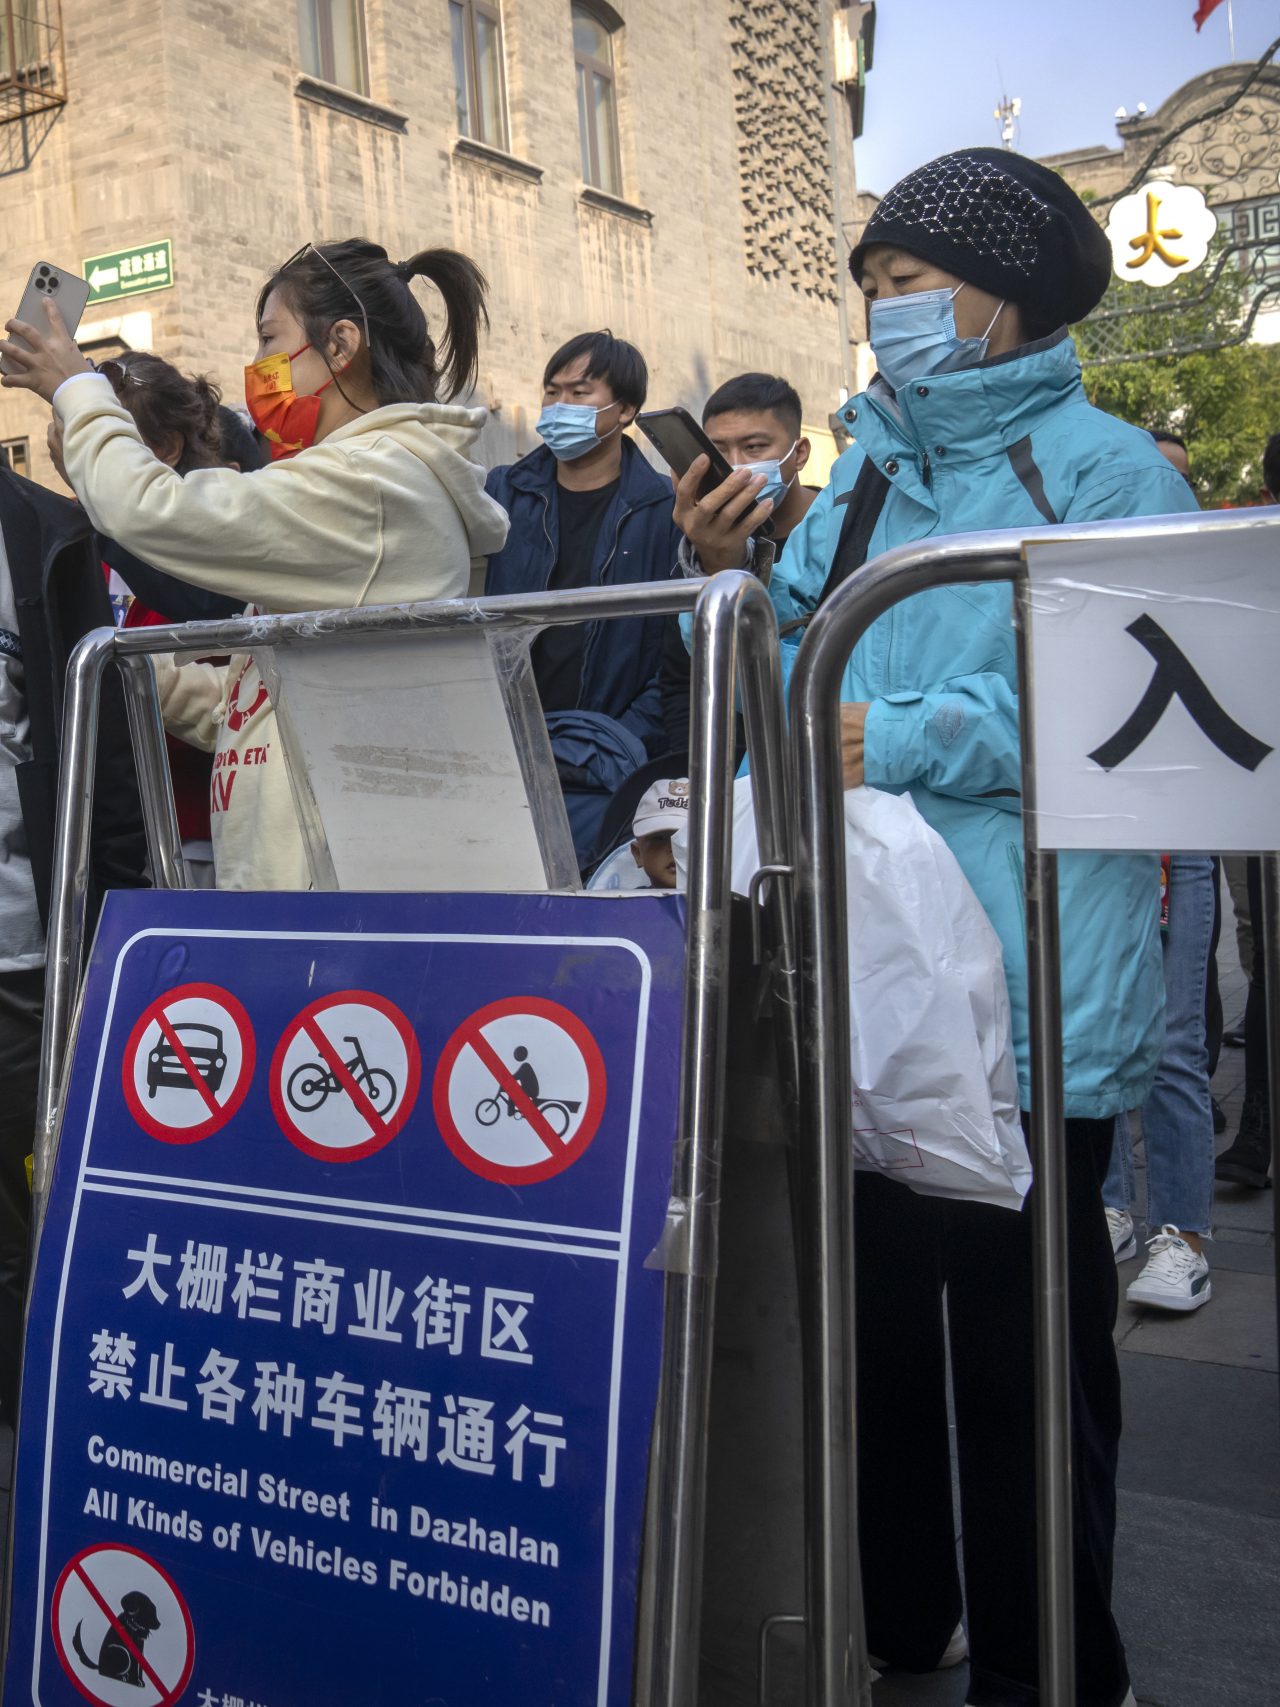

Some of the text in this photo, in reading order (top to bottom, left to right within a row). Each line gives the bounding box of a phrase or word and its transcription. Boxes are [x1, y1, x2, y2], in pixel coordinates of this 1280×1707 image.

[1086, 612, 1275, 773] 入
[121, 1234, 535, 1364] 大栅栏商业街区
[88, 1328, 567, 1488] 禁止各种车辆通行
[83, 1488, 551, 1627] All Kinds of Vehicles Forbidden
[87, 1435, 560, 1567] Commercial Street in Dazhalan
